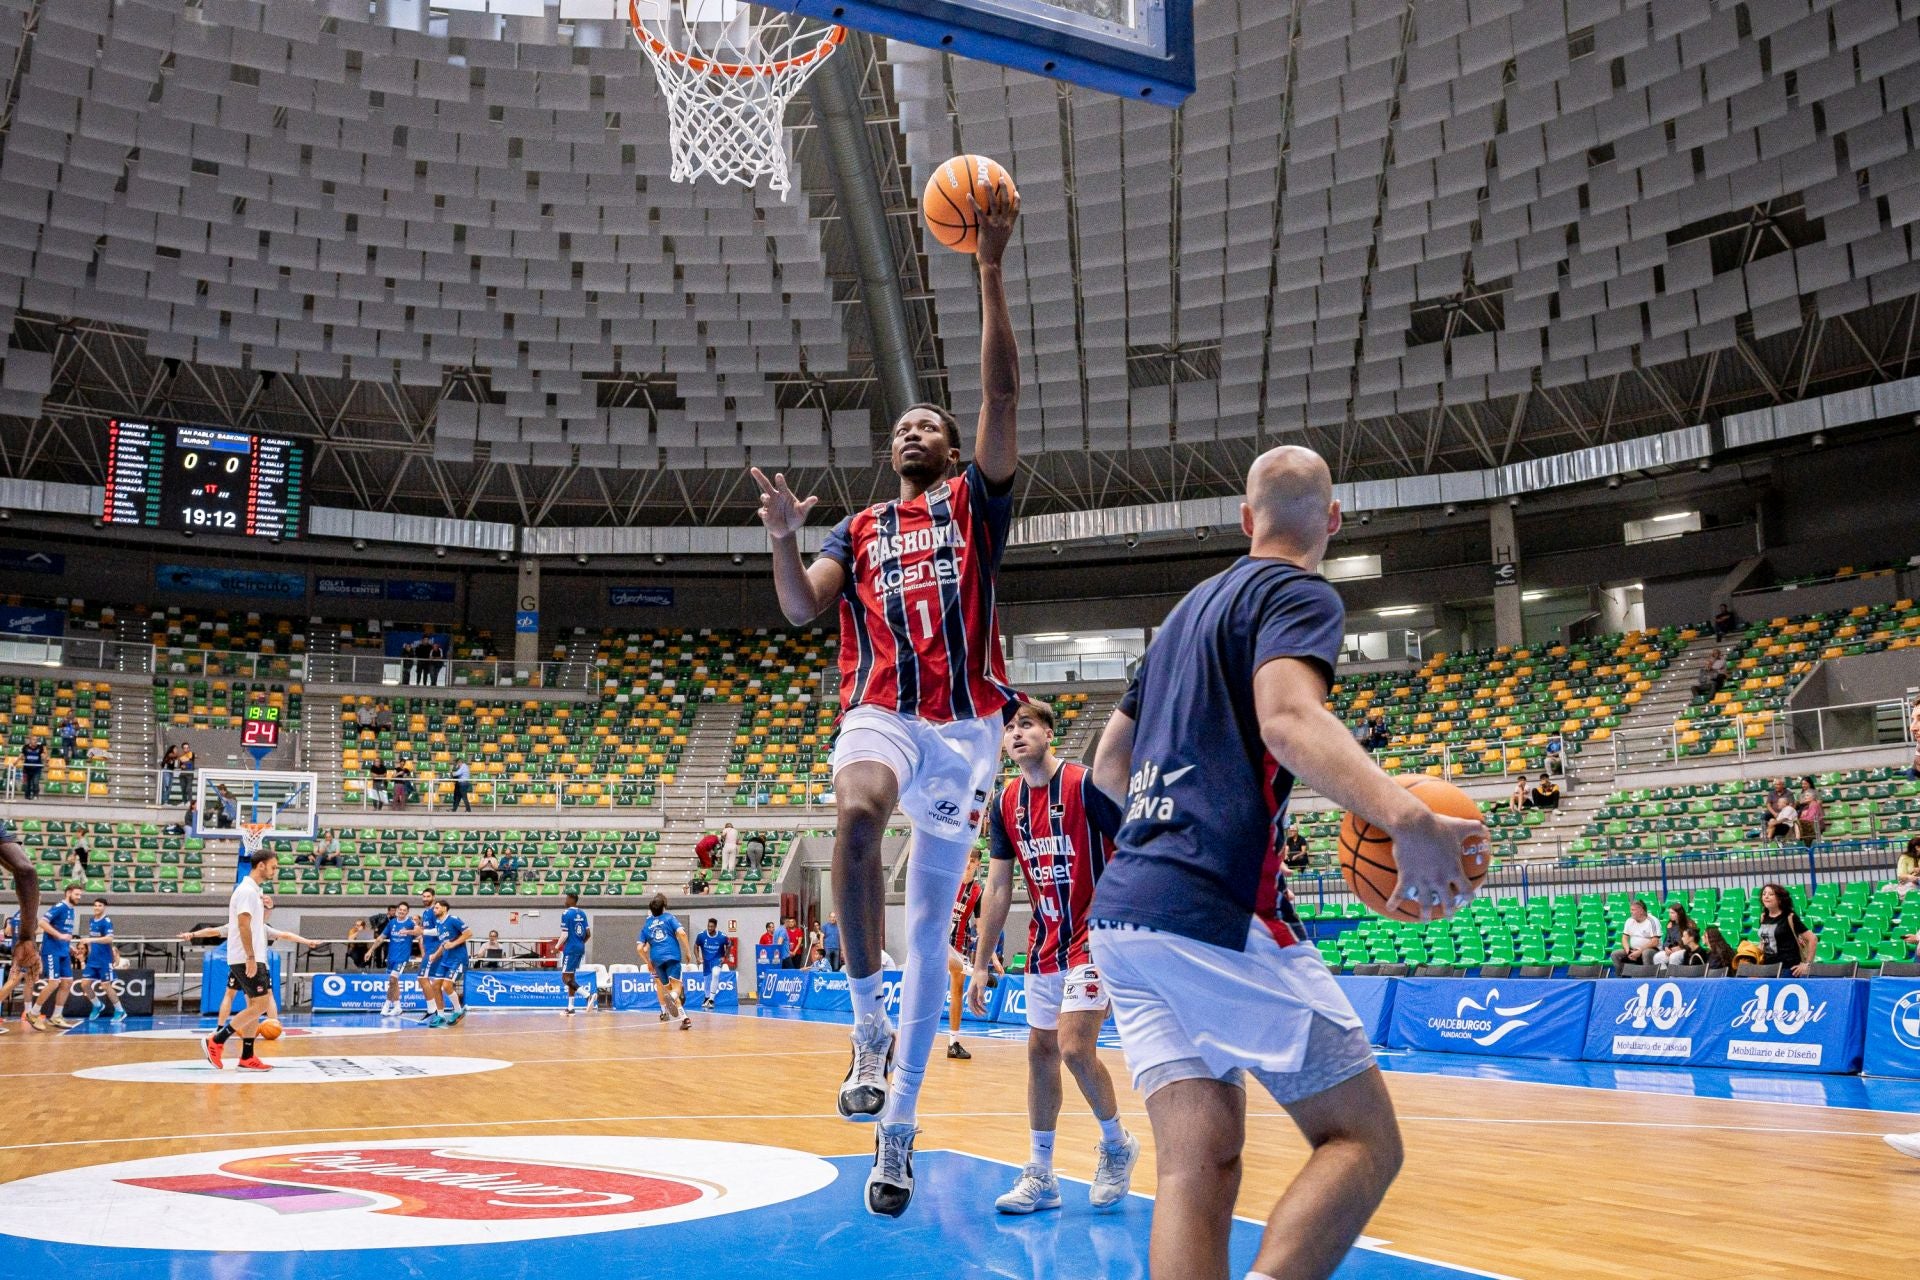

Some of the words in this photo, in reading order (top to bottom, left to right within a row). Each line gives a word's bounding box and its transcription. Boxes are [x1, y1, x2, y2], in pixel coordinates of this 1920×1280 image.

[183, 437, 210, 446] BURGOS
[193, 430, 215, 438] PABLO
[217, 433, 249, 442] BASKONIA
[184, 452, 198, 469] 0
[225, 457, 240, 474] 0
[182, 507, 237, 528] 19:12
[1496, 545, 1511, 564] H
[319, 585, 351, 593] BURGOS
[351, 586, 380, 594] CENTER
[520, 595, 536, 611] G
[915, 599, 934, 640] 1
[248, 706, 279, 720] 19:12
[245, 721, 275, 743] 24
[928, 809, 962, 828] HYUNDAI
[1039, 894, 1060, 922] 4
[509, 981, 561, 993] recoletas
[1615, 996, 1698, 1025] Juvenil
[1631, 982, 1683, 1031] 10
[1730, 998, 1828, 1028] Juvenil
[1749, 983, 1810, 1035] 10
[1440, 1030, 1472, 1040] FUNDACIÓN
[1652, 1042, 1662, 1051] de
[1731, 1046, 1773, 1057] Mobiliario
[1774, 1048, 1786, 1058] de
[1786, 1049, 1817, 1060] Diseño
